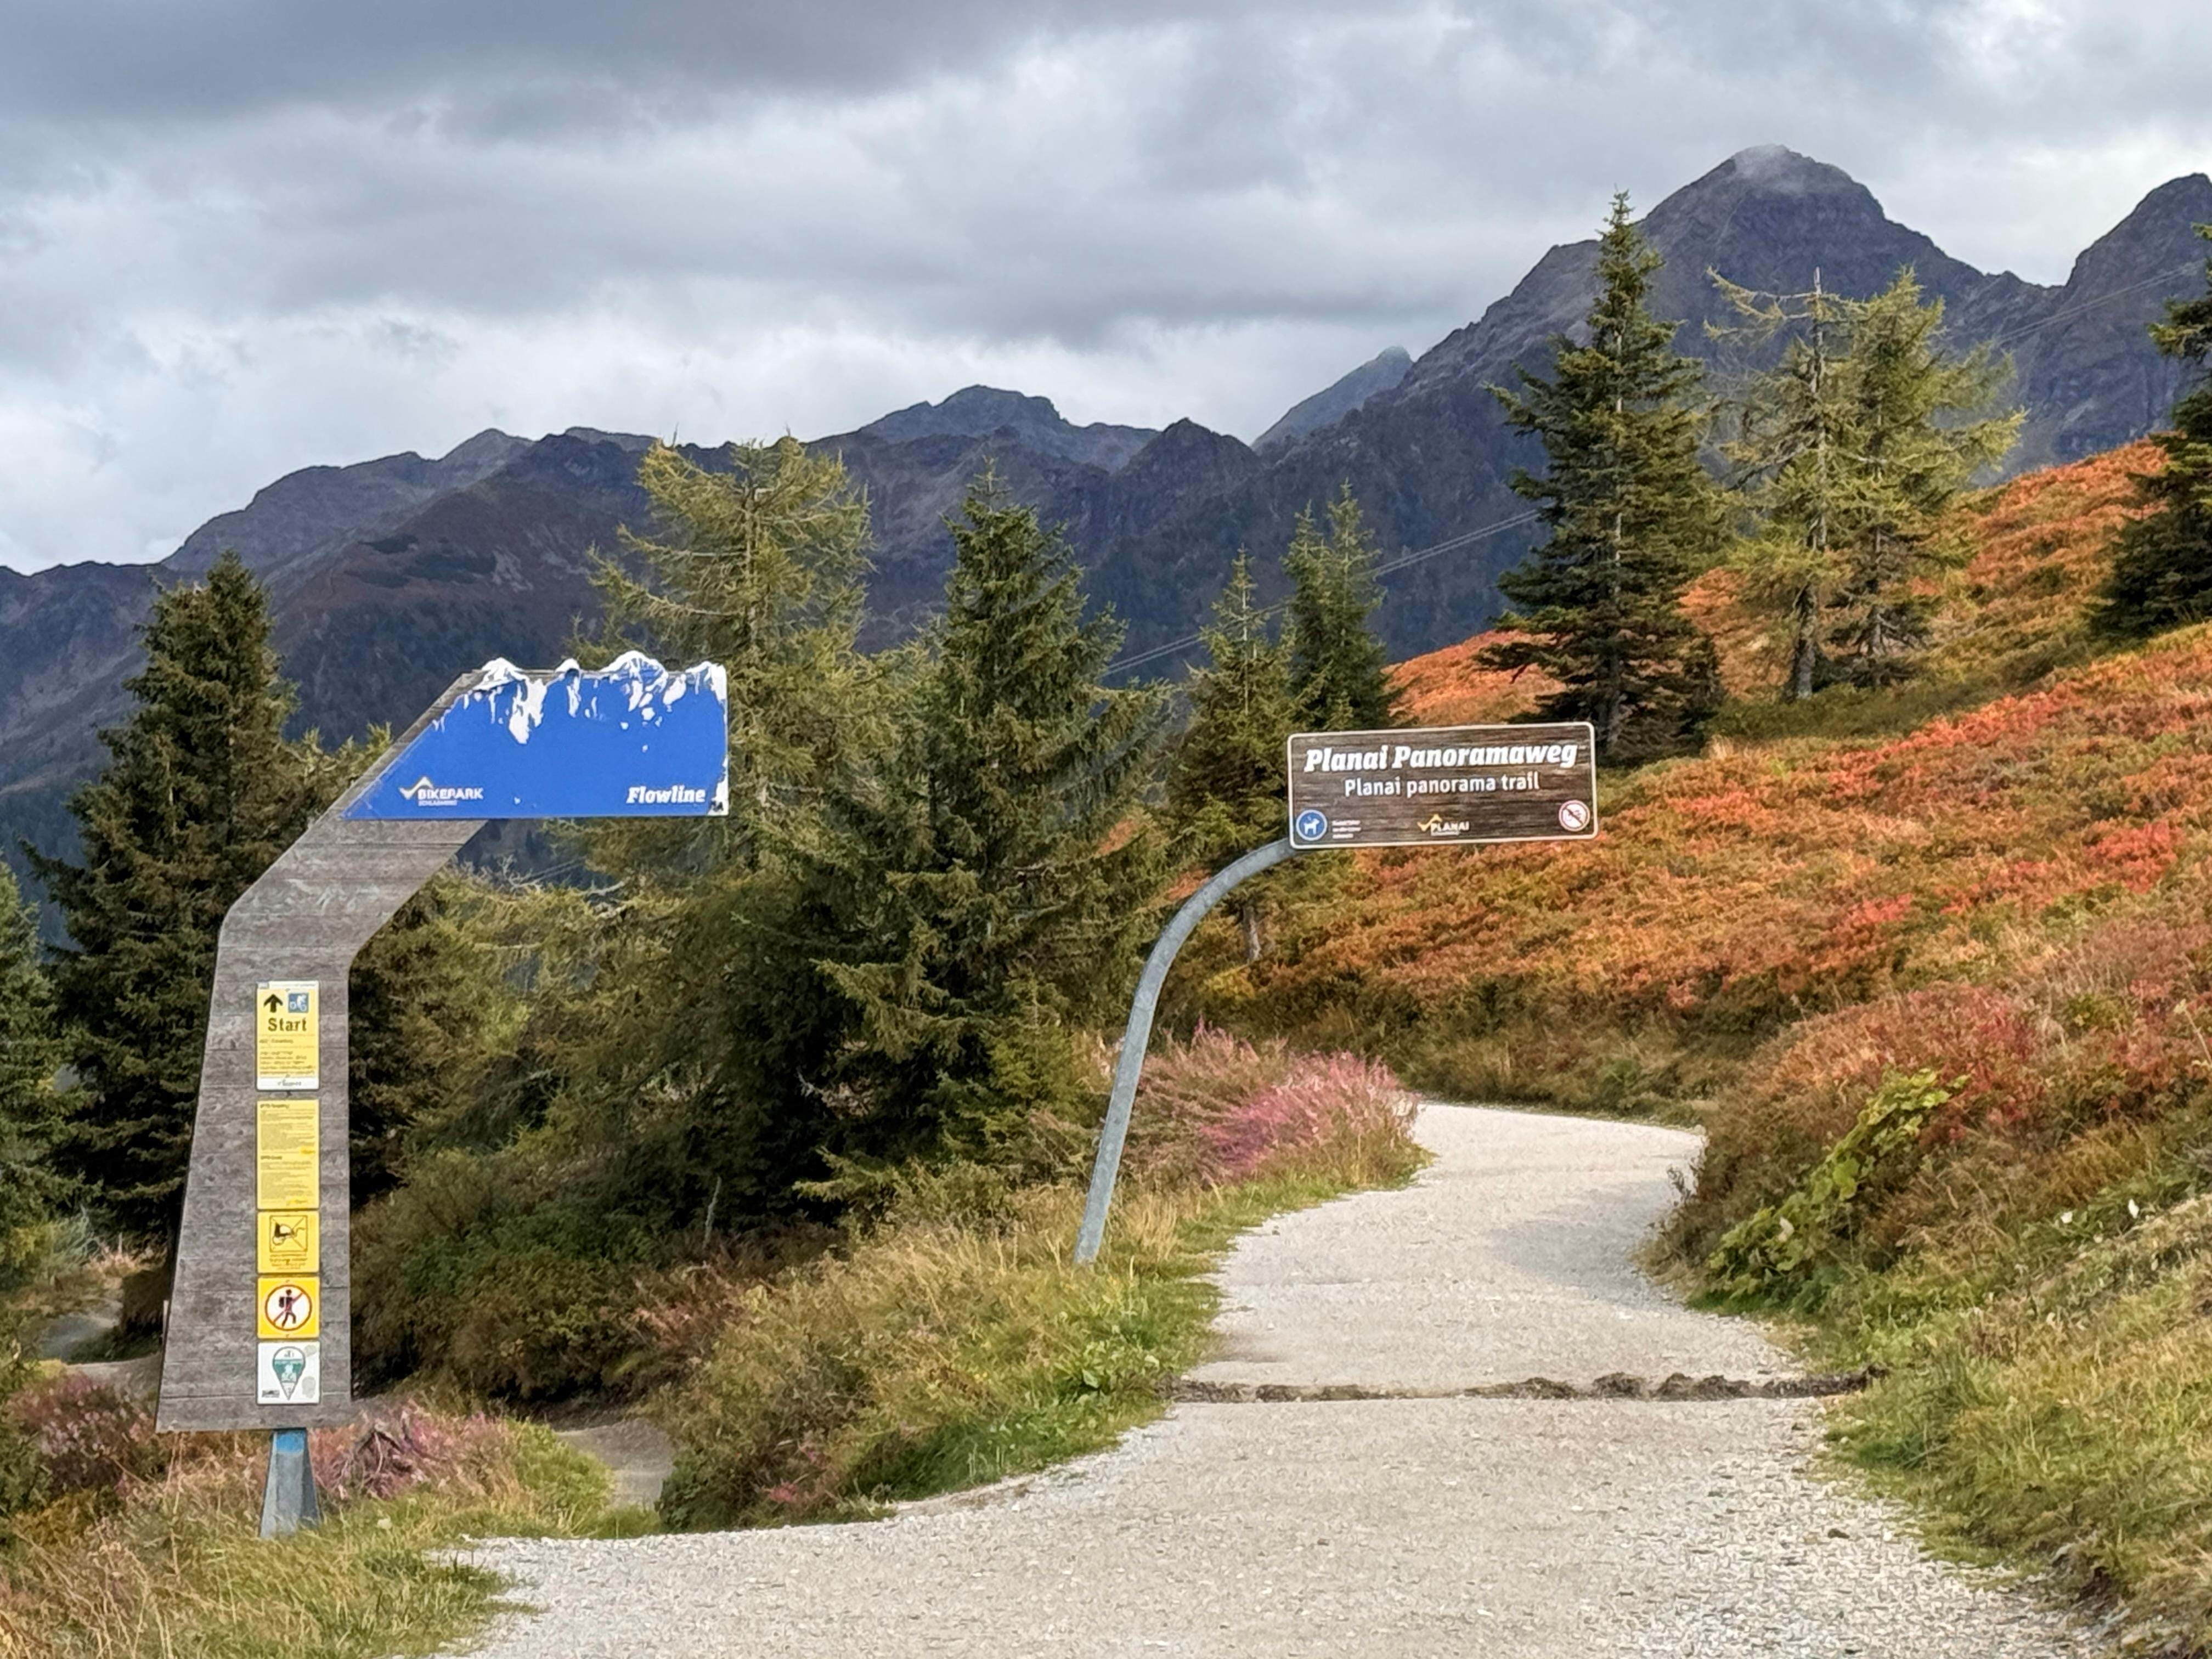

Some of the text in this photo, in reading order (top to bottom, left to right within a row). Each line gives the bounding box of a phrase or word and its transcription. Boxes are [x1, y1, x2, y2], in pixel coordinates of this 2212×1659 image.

[1304, 744, 1578, 772] Planai Panoramaweg
[417, 787, 483, 800] BIKEPARK
[1345, 771, 1539, 798] Planai panorama trail
[626, 785, 706, 804] Flowline
[268, 1018, 307, 1031] Start
